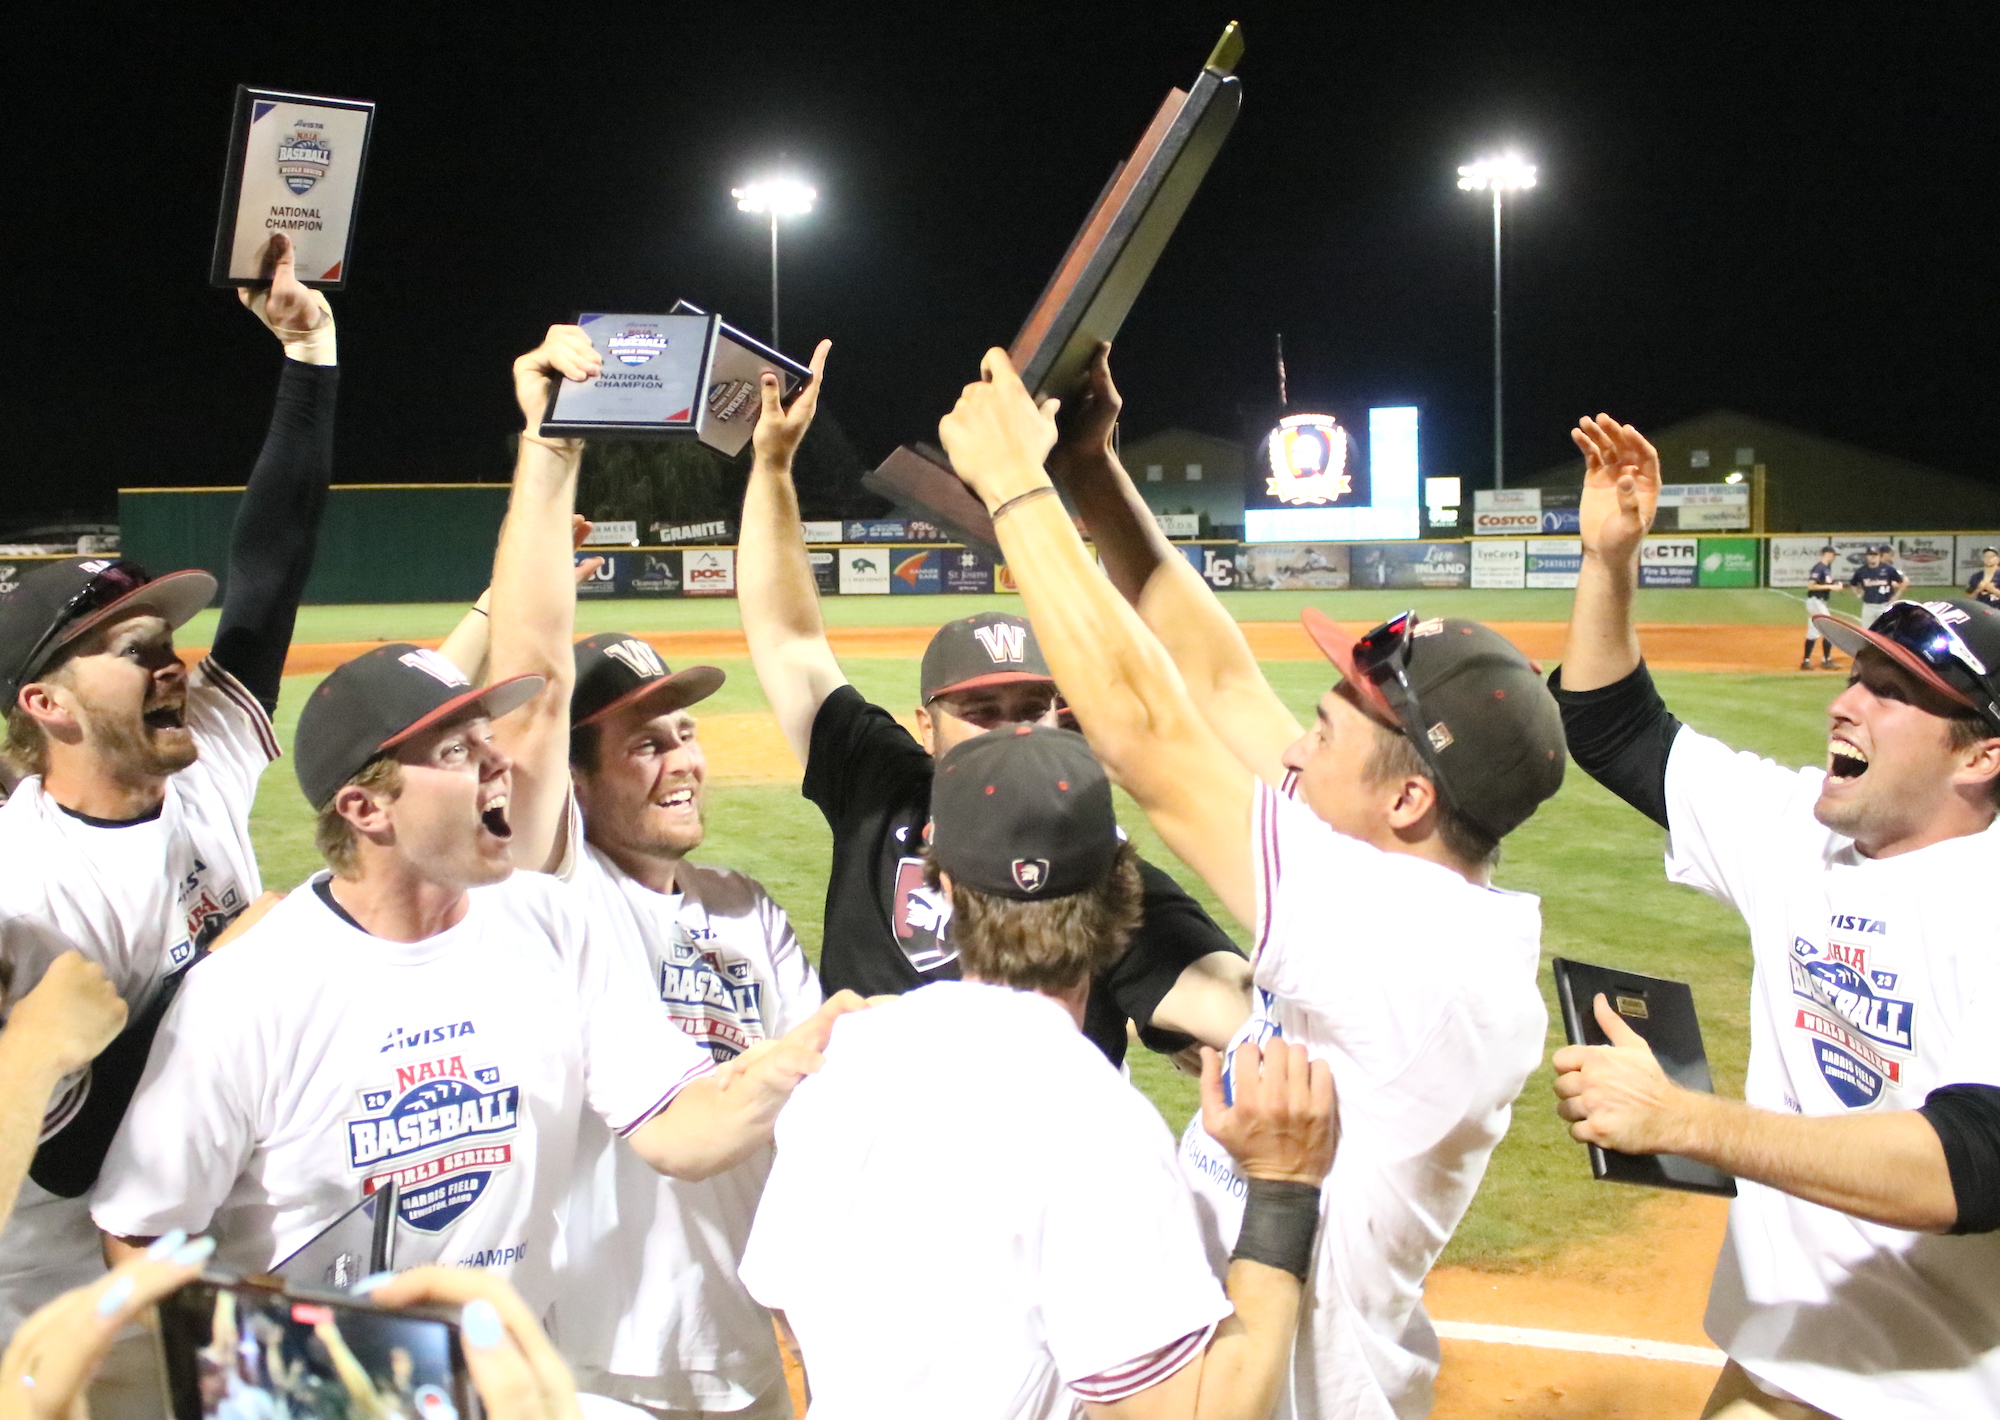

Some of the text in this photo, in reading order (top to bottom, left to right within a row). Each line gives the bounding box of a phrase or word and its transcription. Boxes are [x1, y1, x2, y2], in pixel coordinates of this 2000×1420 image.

[278, 146, 330, 166] BASEBALL
[270, 206, 321, 219] NATIONAL
[265, 218, 322, 231] CHAMPION
[608, 337, 668, 349] BASEBALL
[600, 373, 661, 381] NATIONAL
[594, 381, 664, 389] CHAMPION
[595, 523, 633, 533] RMERS
[660, 520, 727, 542] GRANITE
[1414, 563, 1466, 575] INLAND
[1643, 567, 1694, 576] Fire & Water
[1645, 576, 1692, 585] Restoration
[974, 623, 1027, 664] W
[603, 639, 665, 679] W
[398, 648, 471, 688] W
[1830, 914, 1886, 936] ISTA
[173, 945, 189, 960] 20
[676, 946, 688, 957] 20
[1795, 939, 1812, 954] 20
[734, 965, 747, 978] 23
[1876, 974, 1893, 987] 23
[379, 1020, 476, 1054] AVISTA
[1803, 1012, 1891, 1077] WORLD SERIES
[395, 1055, 468, 1093] NAIA
[482, 1068, 498, 1083] 23
[1821, 1047, 1875, 1089] HARRIS FIELD
[367, 1094, 386, 1108] 20
[350, 1091, 517, 1165] BASEBALL
[443, 1147, 506, 1172] SERIES
[402, 1178, 479, 1210] HARRIS FIELD
[456, 1241, 529, 1269] HAMPIO
